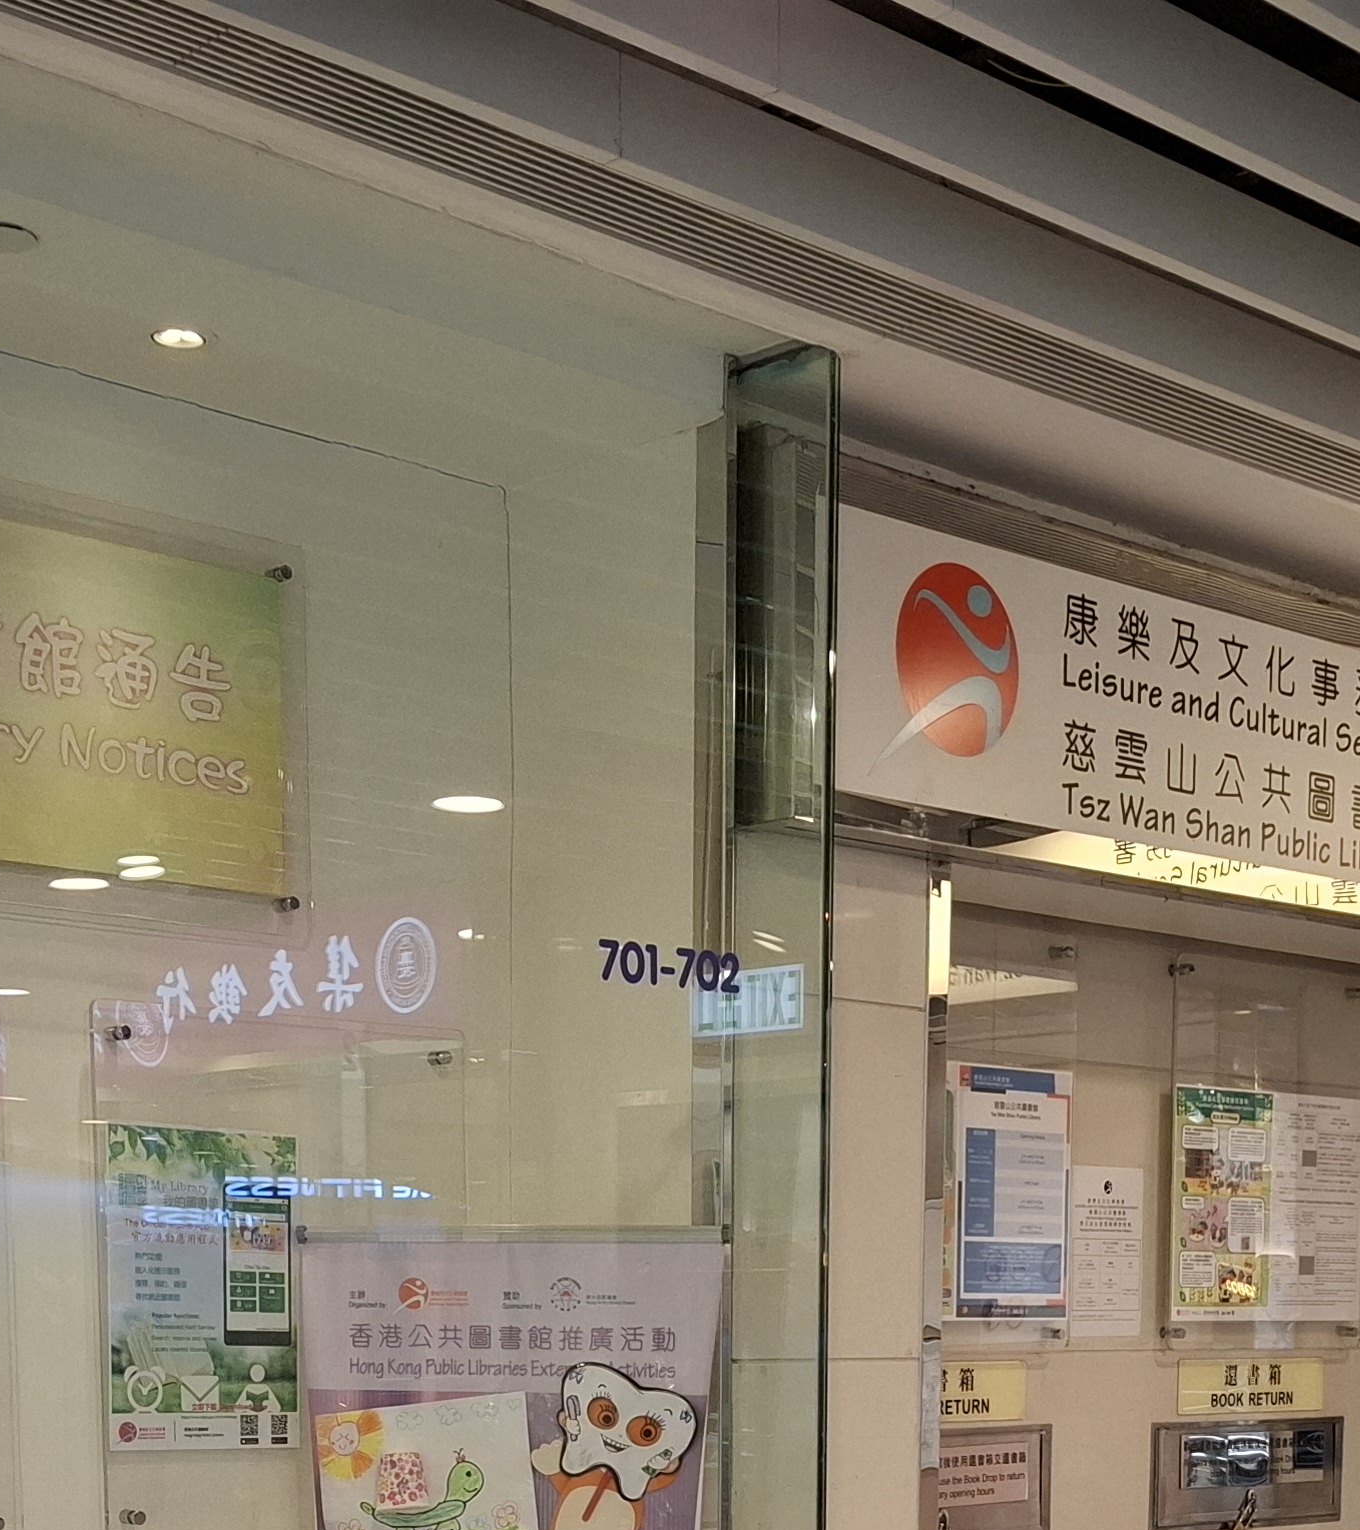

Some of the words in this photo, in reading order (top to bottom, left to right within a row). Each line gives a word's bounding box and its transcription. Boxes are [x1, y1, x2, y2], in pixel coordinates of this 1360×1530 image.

[1061, 651, 1164, 710] Leisure
[1170, 686, 1221, 725] and
[1228, 696, 1329, 750] Cultural
[60, 722, 250, 796] Notices
[1061, 781, 1112, 823] Tsz
[1119, 791, 1176, 835] Wan
[1184, 807, 1252, 851] Shan
[1260, 820, 1332, 866] Public
[597, 937, 741, 994] 701-702
[169, 1181, 209, 1195] Library
[347, 1322, 678, 1353] 香港公共圖書館推廣活動
[348, 1357, 385, 1380] Hong
[386, 1358, 423, 1380] Kong
[424, 1357, 466, 1377] Public
[467, 1358, 529, 1377] Libraries
[1224, 1363, 1282, 1387] 還書箱
[1210, 1392, 1245, 1408] BOOK
[1248, 1390, 1294, 1407] RETURN
[963, 1474, 981, 1485] Book
[981, 1473, 998, 1484] Drop
[998, 1473, 1006, 1481] to
[1006, 1472, 1026, 1481] return
[948, 1488, 976, 1500] opening
[976, 1487, 996, 1497] hours
